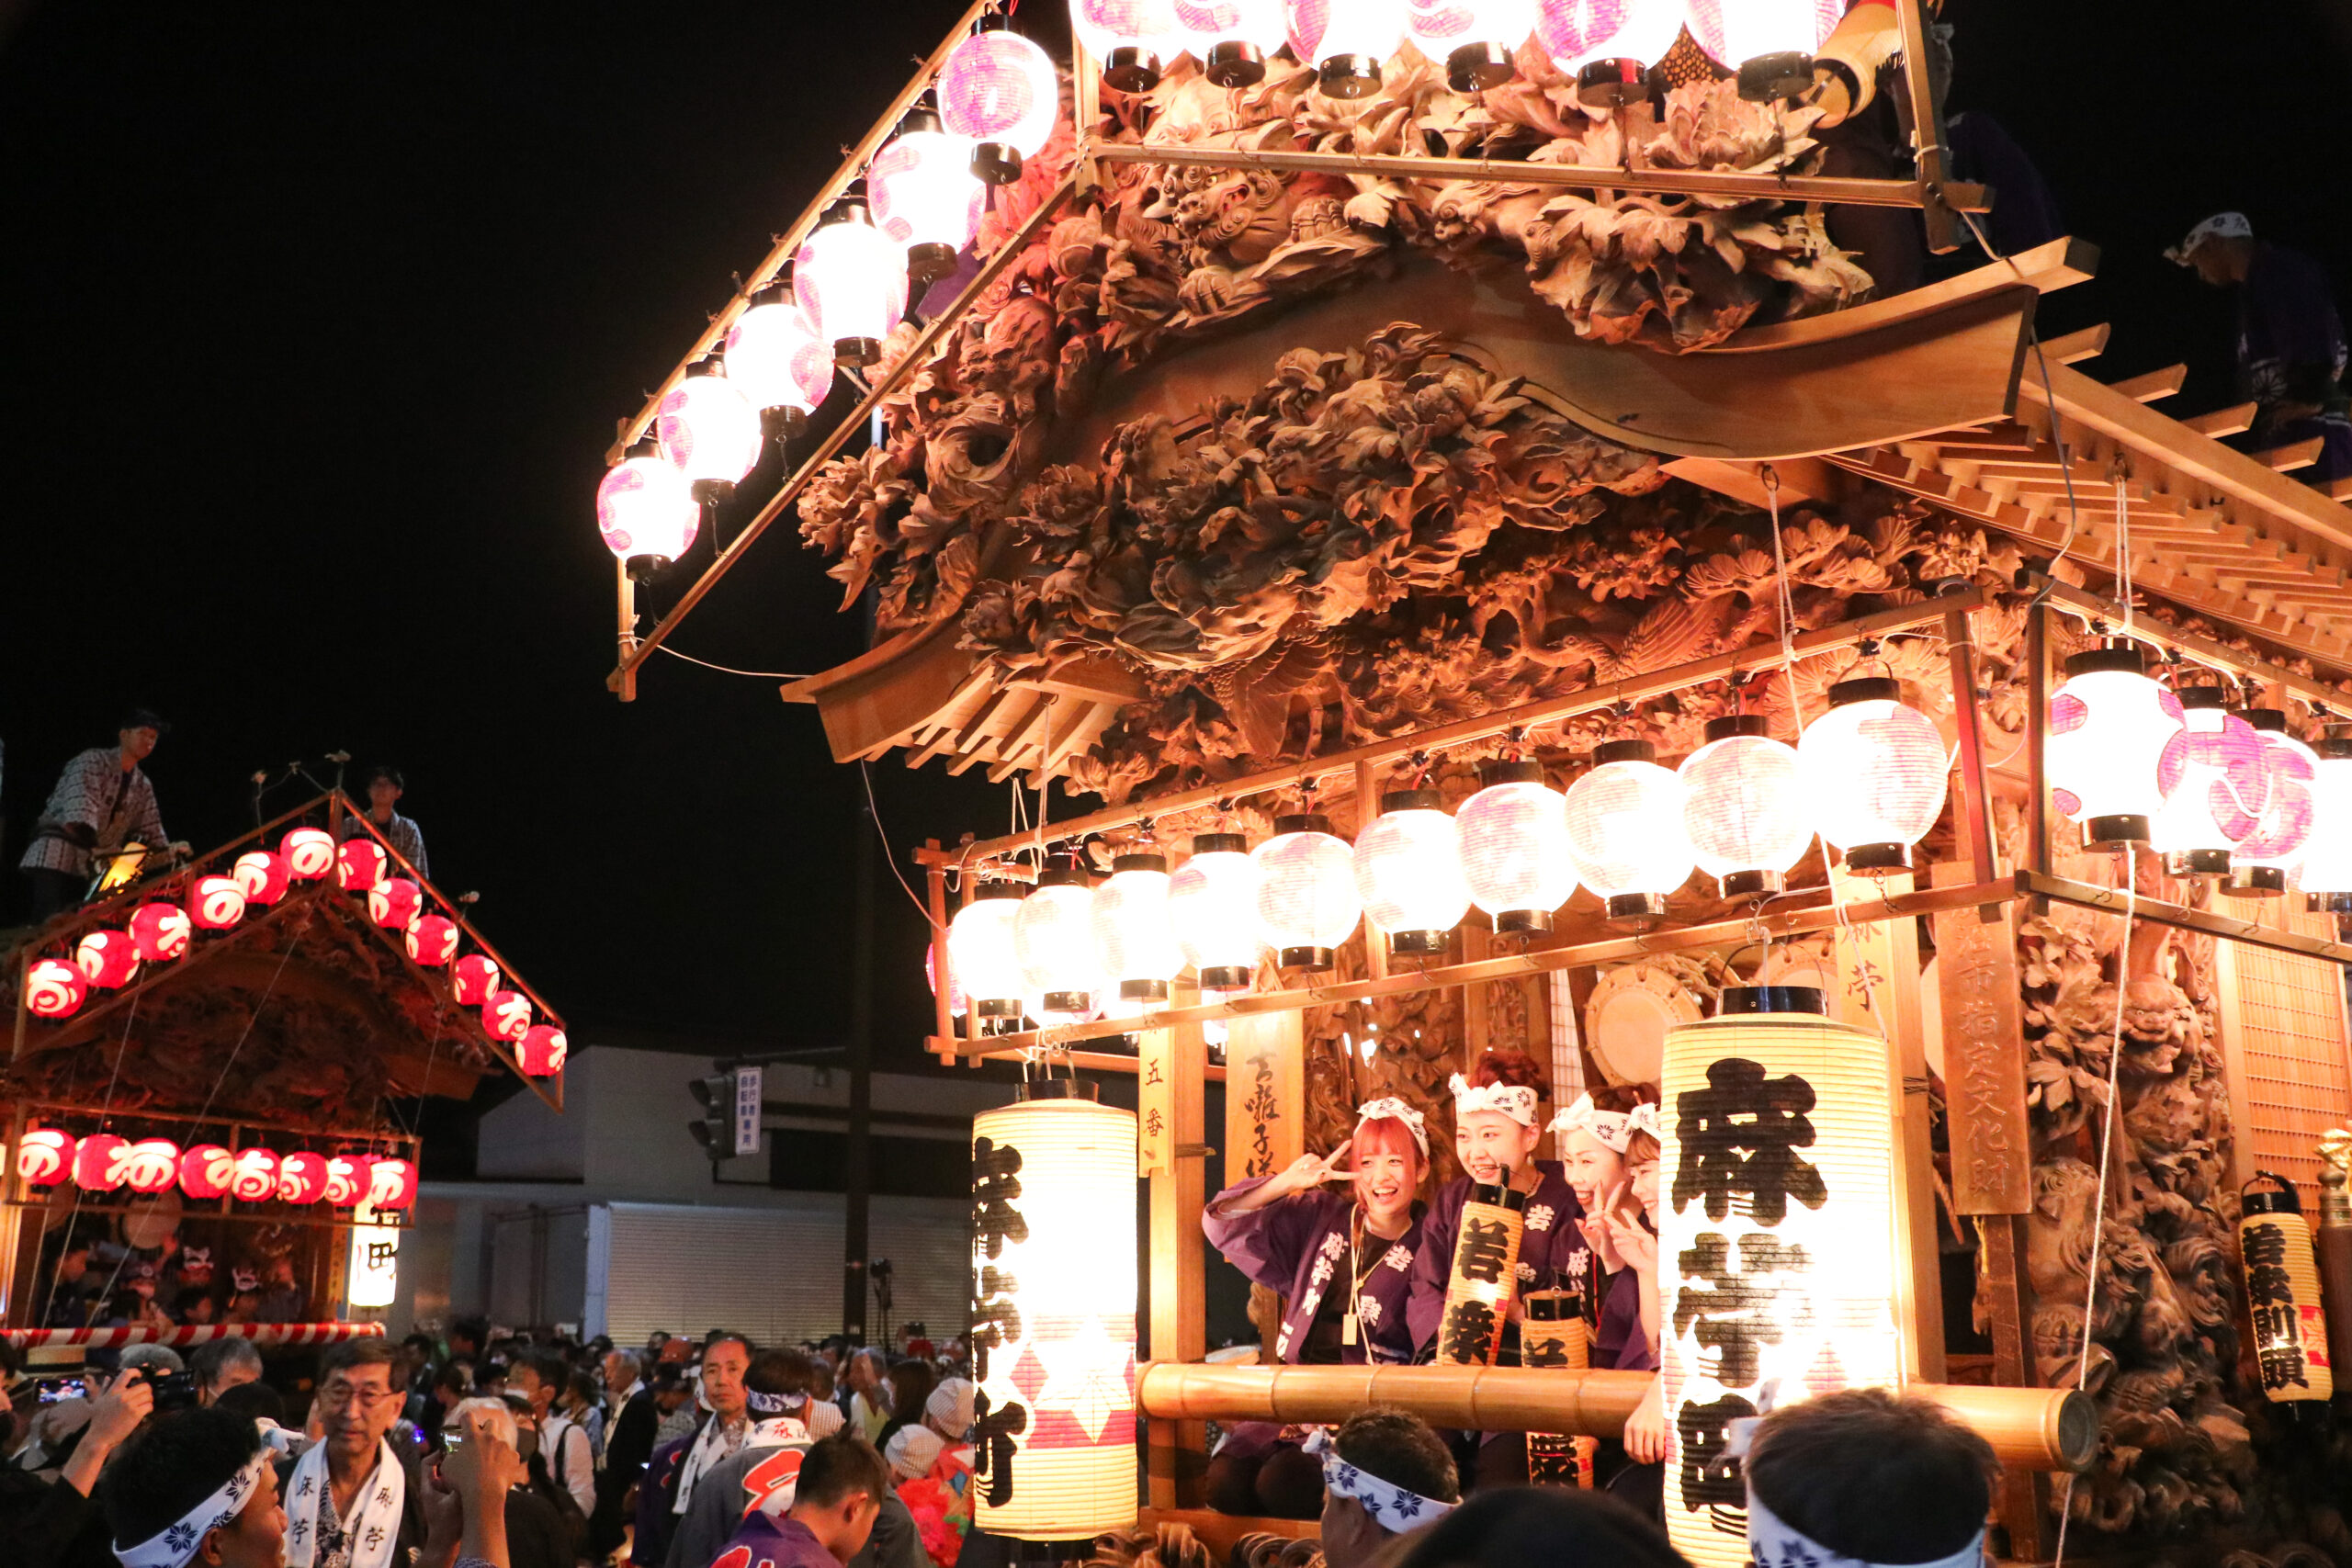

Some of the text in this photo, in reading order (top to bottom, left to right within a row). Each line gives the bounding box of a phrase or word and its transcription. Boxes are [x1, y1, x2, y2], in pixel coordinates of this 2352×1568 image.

[1143, 1027, 1164, 1137] 五番
[1951, 905, 2010, 1196] 沼市指定文化財
